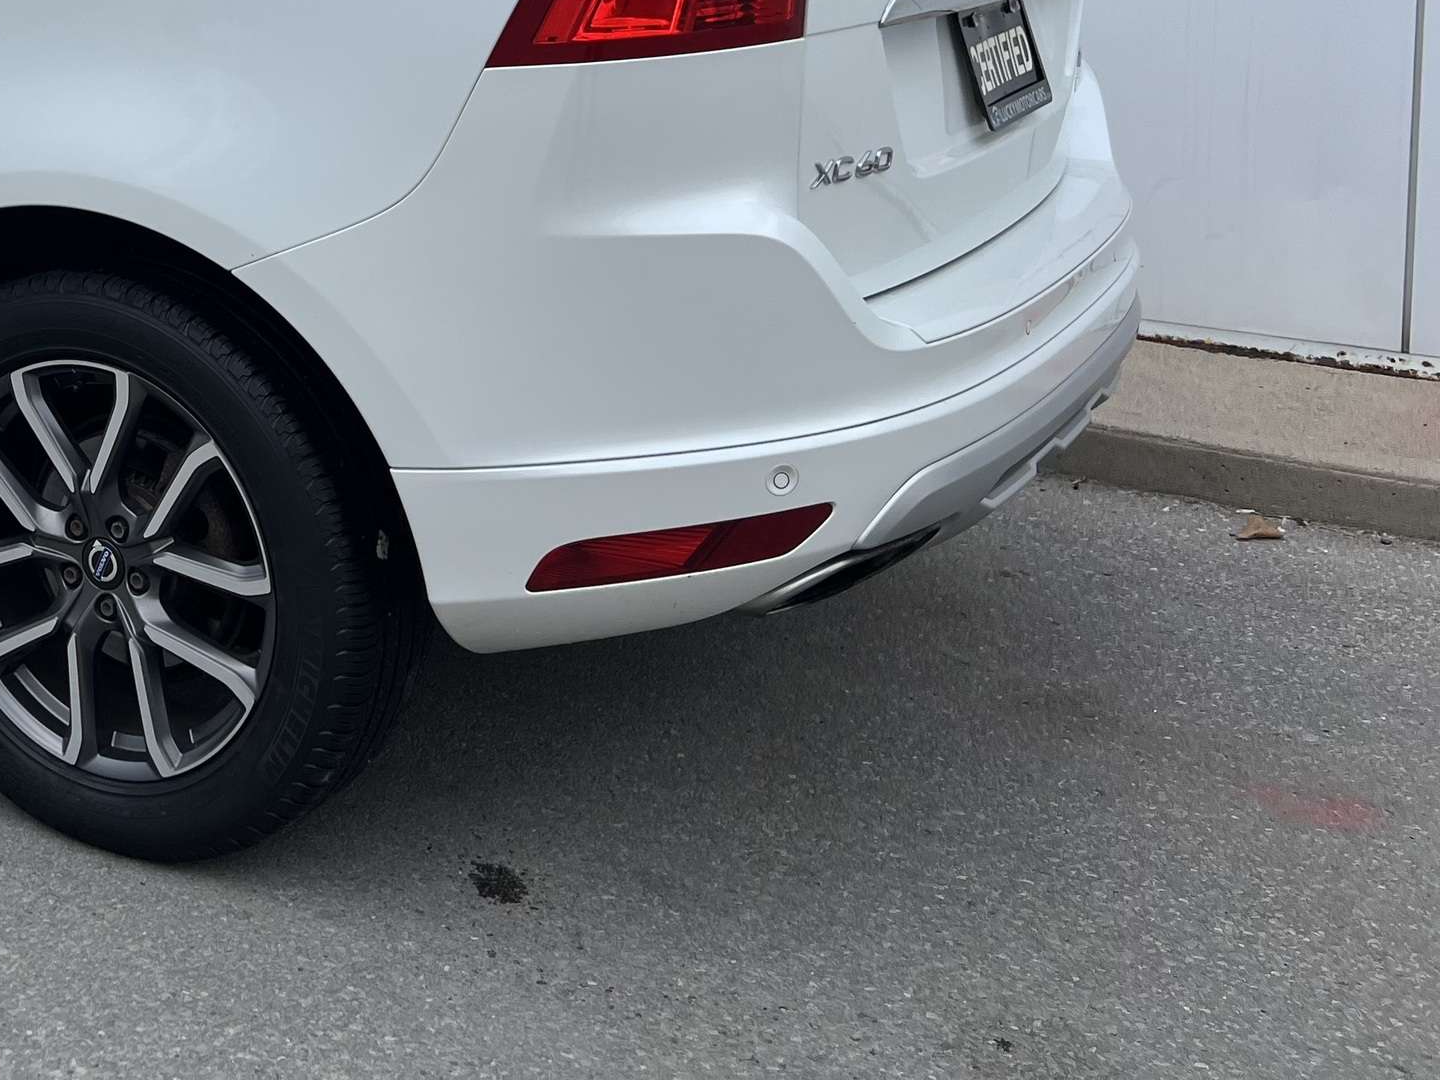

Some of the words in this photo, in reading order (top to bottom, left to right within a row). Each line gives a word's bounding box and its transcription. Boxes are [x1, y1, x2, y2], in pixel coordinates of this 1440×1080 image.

[970, 25, 1033, 96] CERTIFIED
[809, 146, 894, 190] XC60
[95, 550, 110, 577] VOLVO
